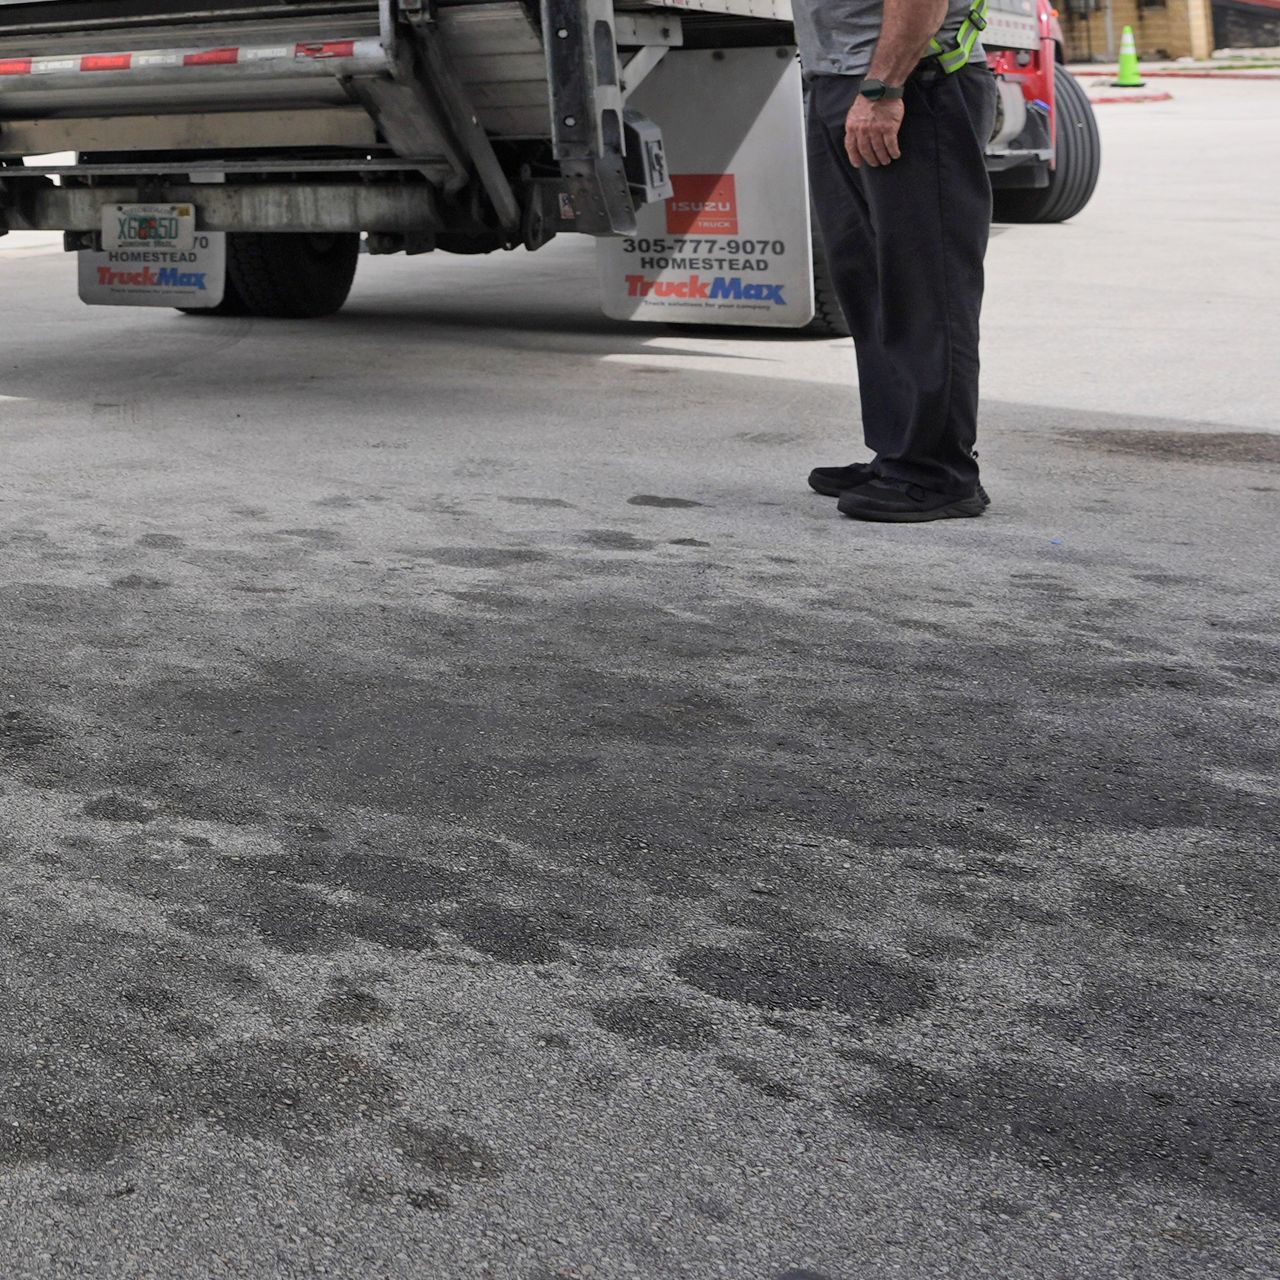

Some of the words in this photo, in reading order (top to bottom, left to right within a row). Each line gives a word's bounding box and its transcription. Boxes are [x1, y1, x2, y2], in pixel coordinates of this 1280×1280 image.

[671, 200, 731, 212] ISUZU
[697, 220, 731, 228] TRUCK
[622, 238, 786, 256] 305-777-9070
[108, 251, 198, 263] HOMESTEAD
[640, 256, 770, 272] HOMESTEAD
[96, 266, 207, 290] TruckMax
[624, 274, 787, 306] TruckMax
